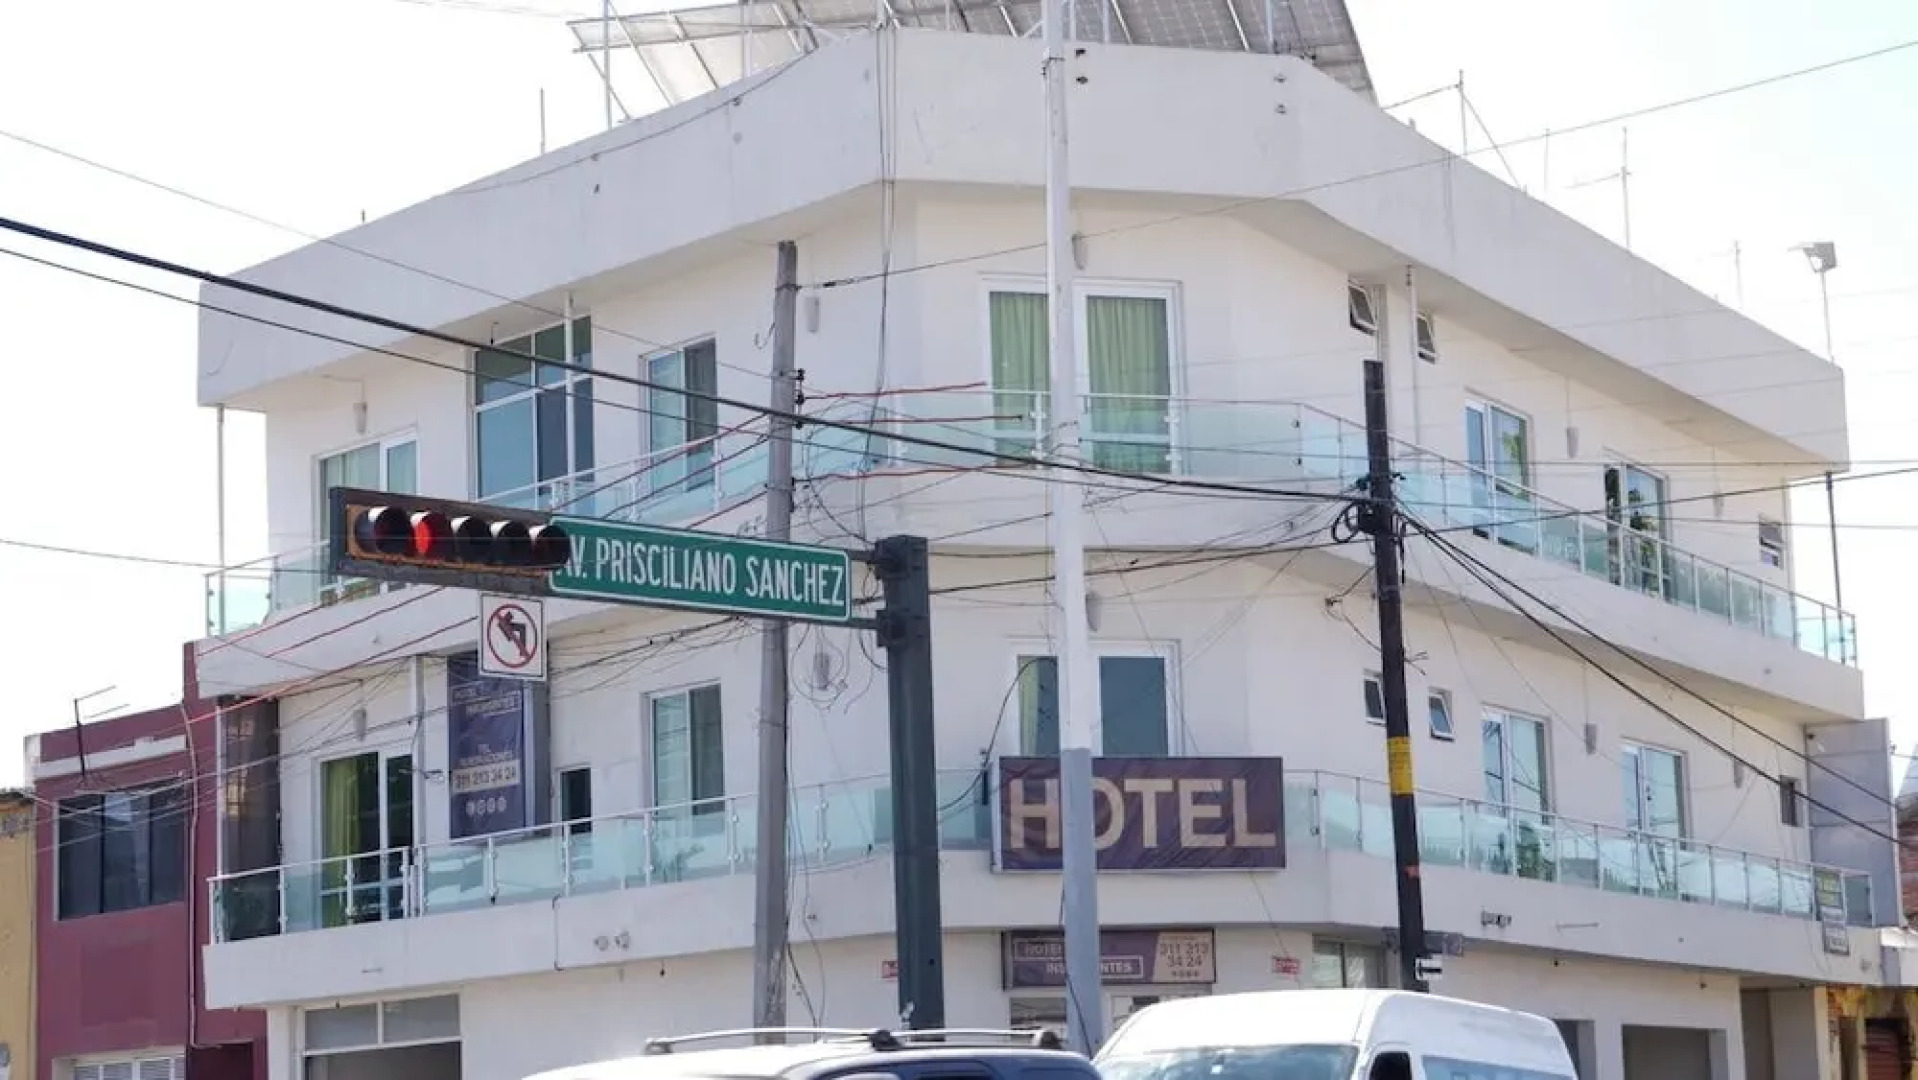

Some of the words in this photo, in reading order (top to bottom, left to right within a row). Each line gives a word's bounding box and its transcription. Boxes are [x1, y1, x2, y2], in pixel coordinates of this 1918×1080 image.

[556, 535, 587, 579] V.
[596, 537, 736, 595] PRISCILIANO
[745, 556, 845, 606] SANCHEZ
[1009, 778, 1276, 849] HOTEL
